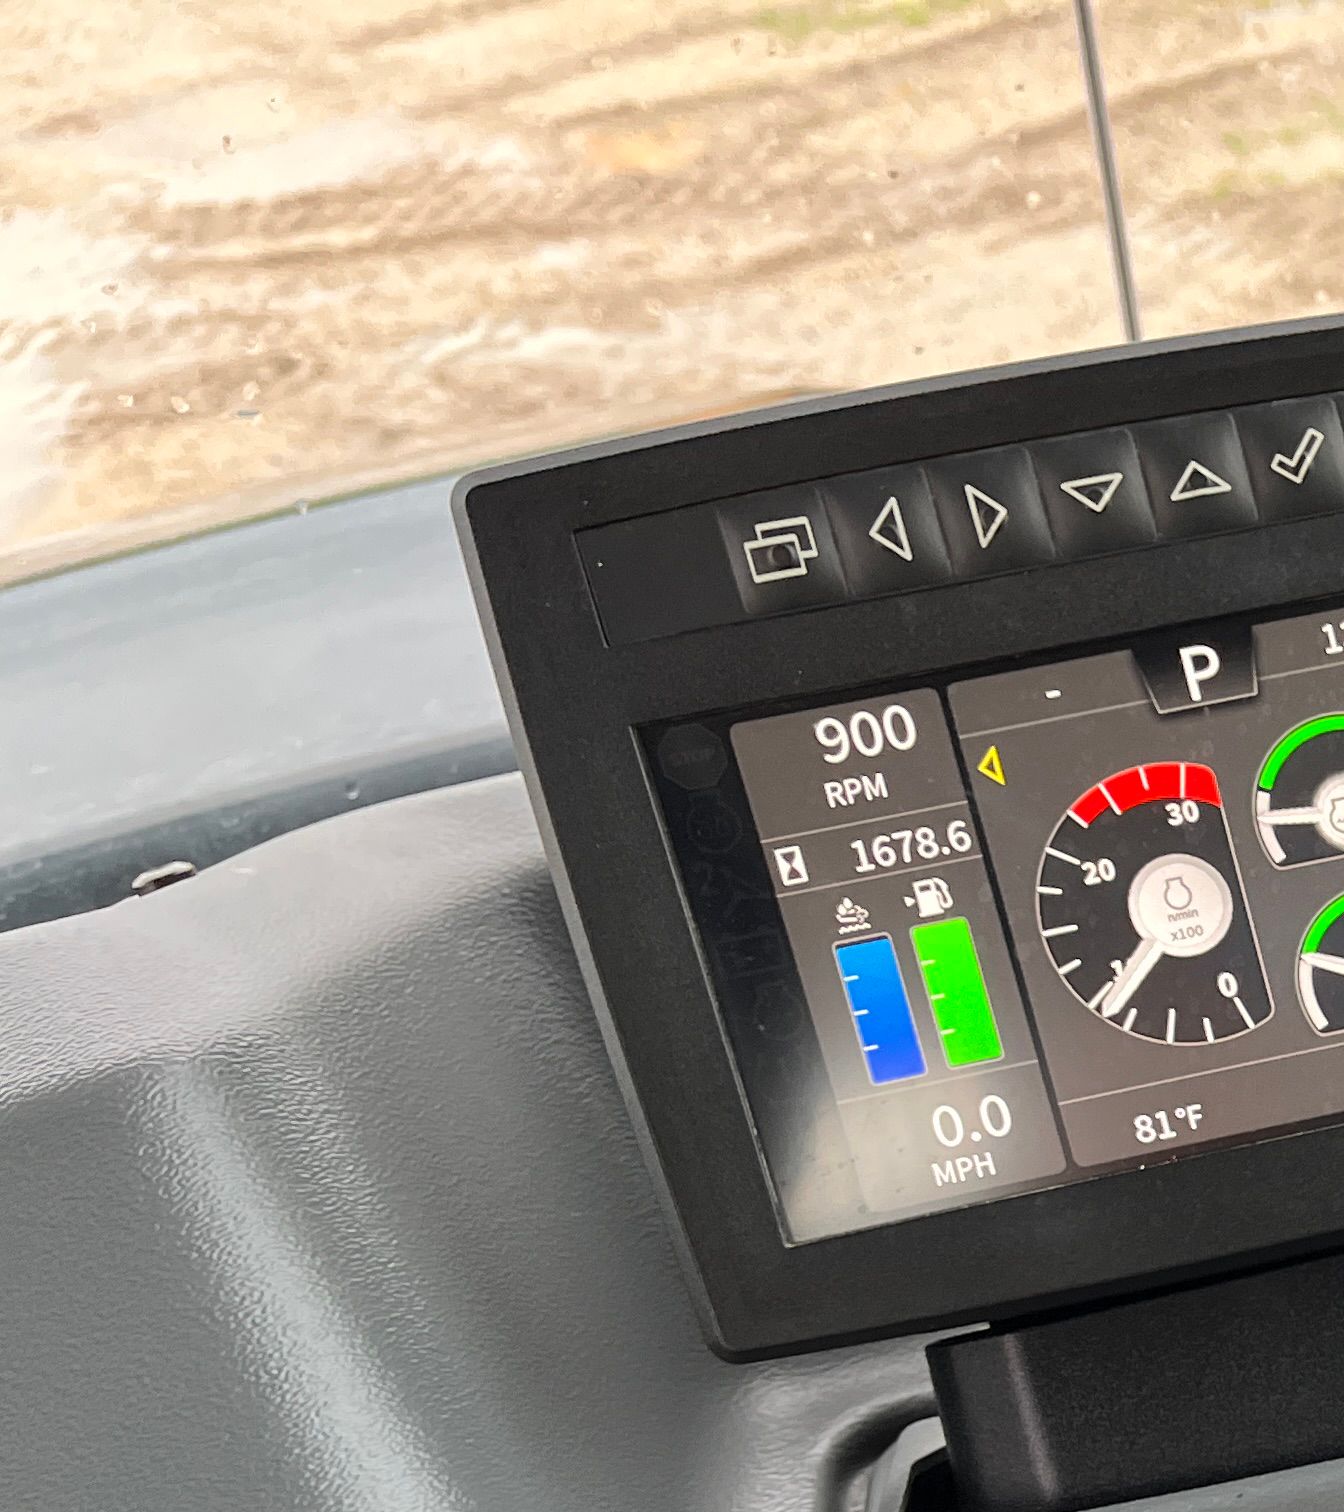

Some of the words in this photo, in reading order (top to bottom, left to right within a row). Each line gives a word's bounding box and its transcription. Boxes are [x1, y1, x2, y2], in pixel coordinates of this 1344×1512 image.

[1178, 644, 1221, 702] P
[813, 704, 918, 764] 900
[824, 772, 889, 809] RPM
[1164, 800, 1200, 826] 30
[850, 819, 973, 873] 1678.6
[1081, 858, 1116, 885] 20
[1170, 925, 1204, 942] x100
[1216, 971, 1239, 998] 0
[931, 1094, 1012, 1148] 0.0
[1133, 1103, 1204, 1144] 81°F
[931, 1151, 998, 1187] MPH
